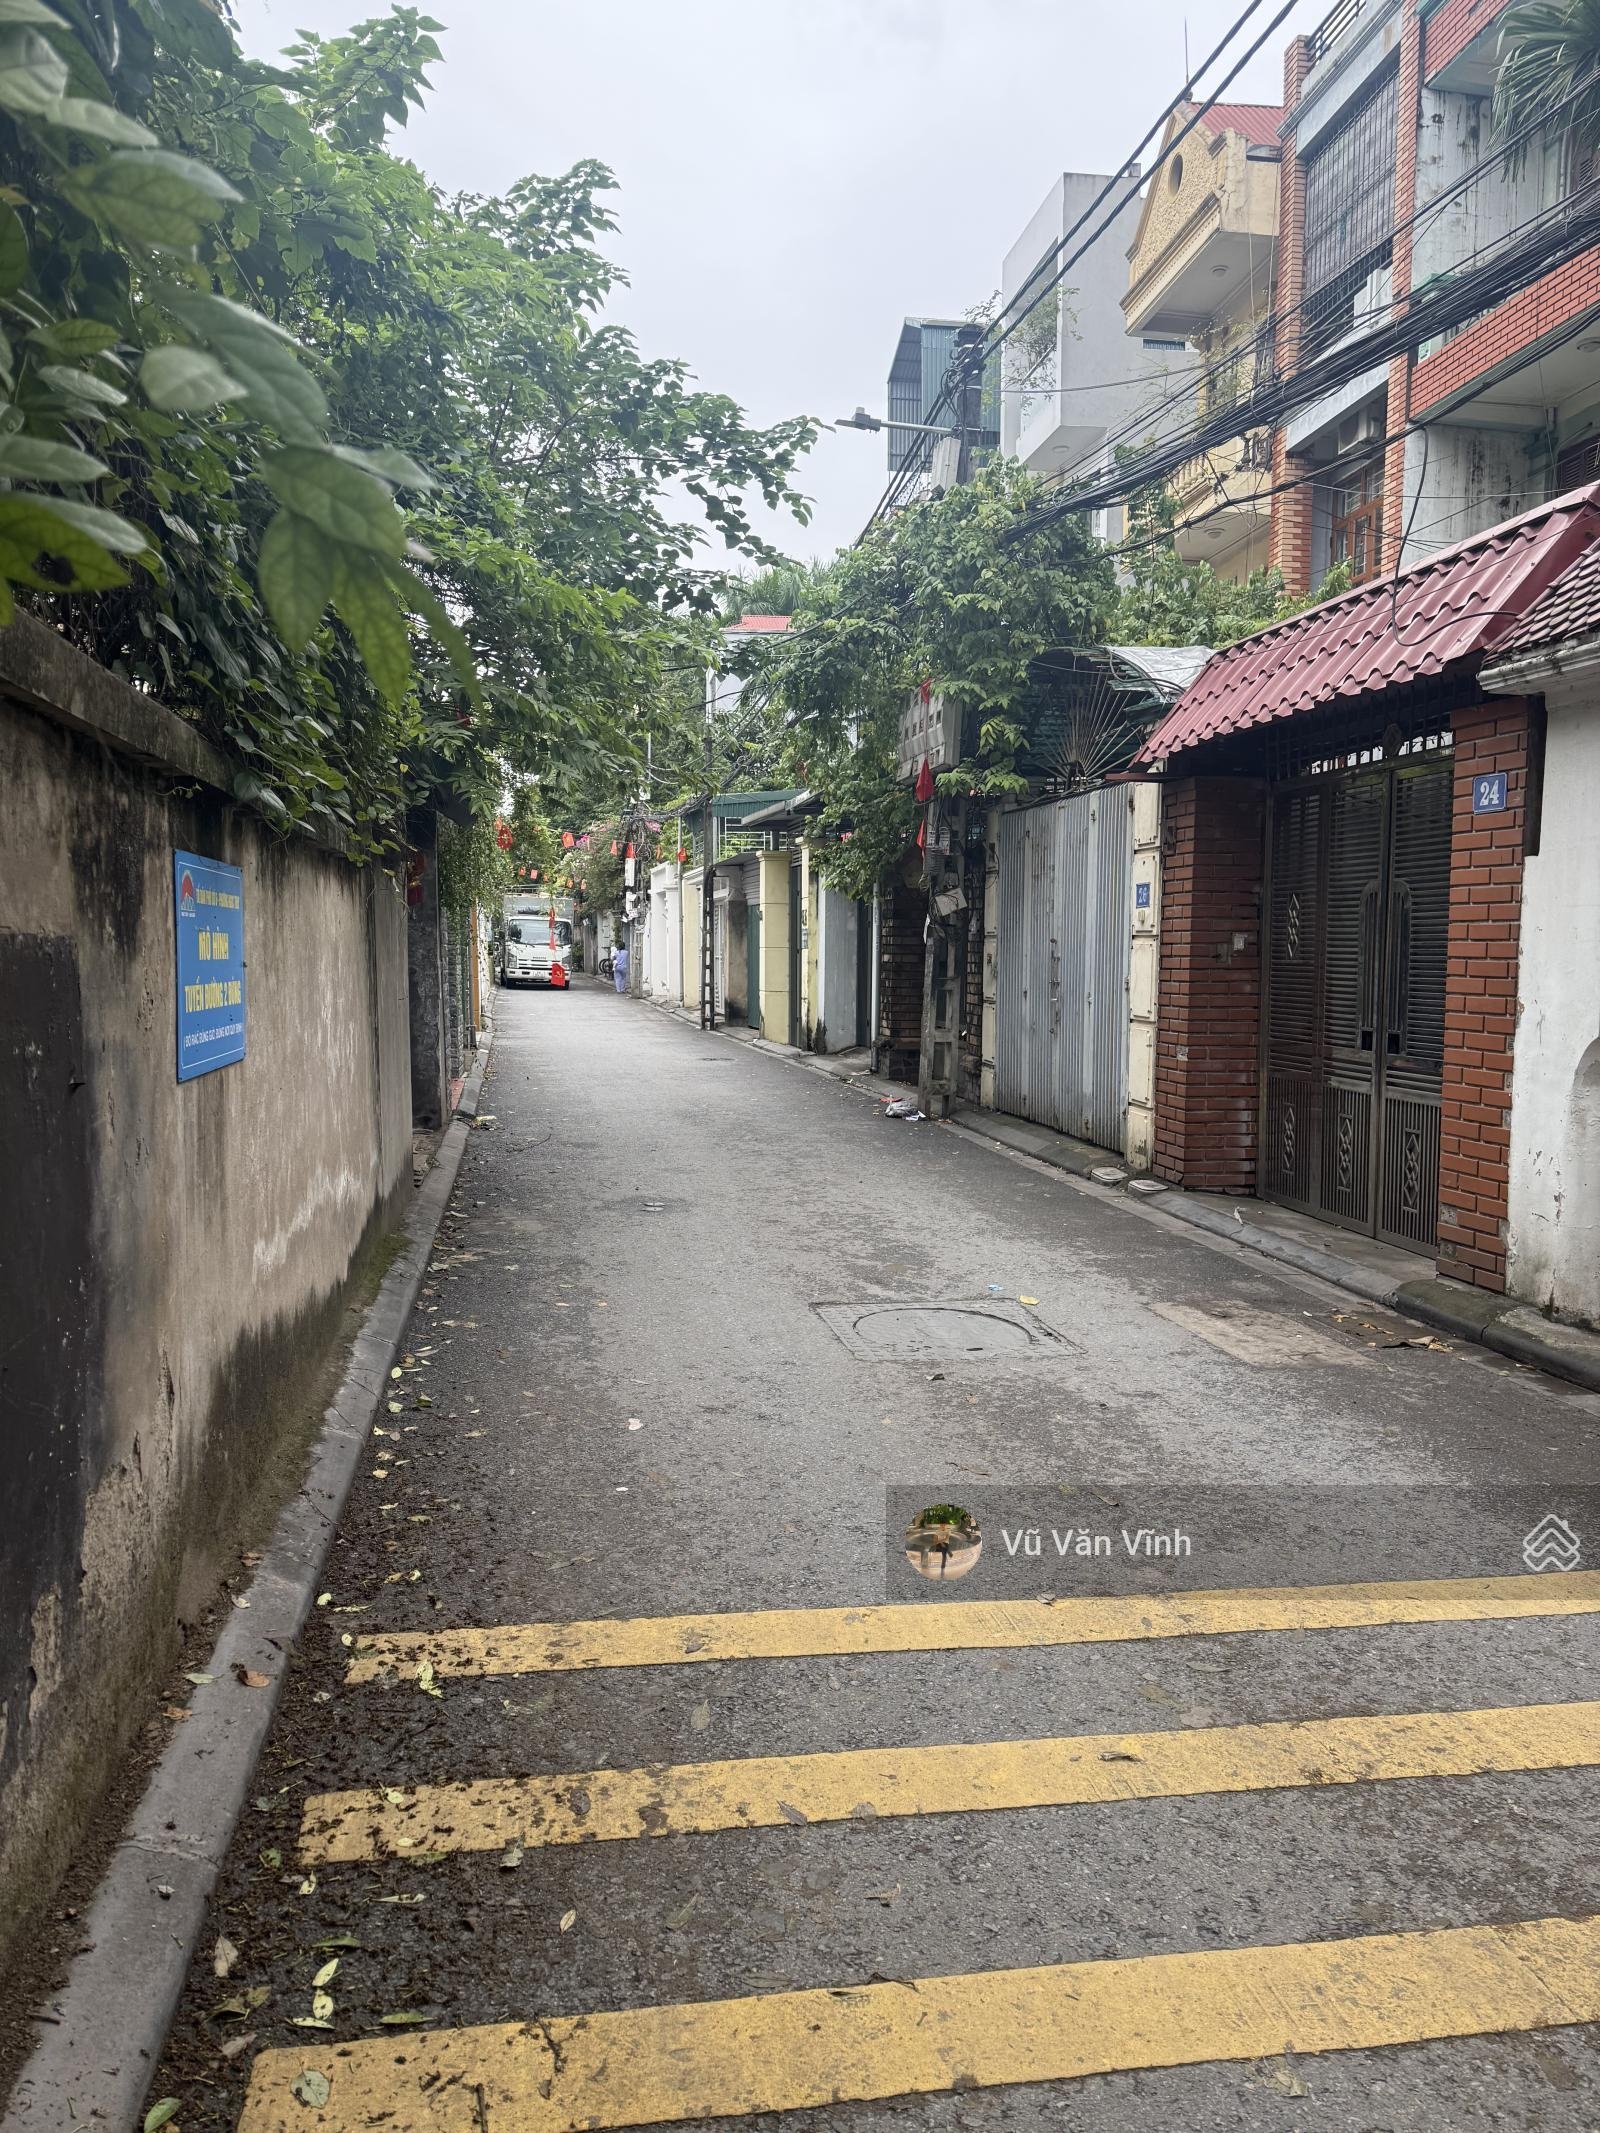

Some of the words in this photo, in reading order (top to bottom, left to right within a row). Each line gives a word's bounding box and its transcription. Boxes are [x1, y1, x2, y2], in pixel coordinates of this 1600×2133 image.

[1480, 780, 1499, 806] 24
[198, 926, 211, 960] MÔ
[213, 926, 229, 960] HÌNH
[184, 976, 204, 1013] TUYẾN
[204, 976, 223, 1010] ĐƯỜNG
[223, 983, 228, 1006] 2
